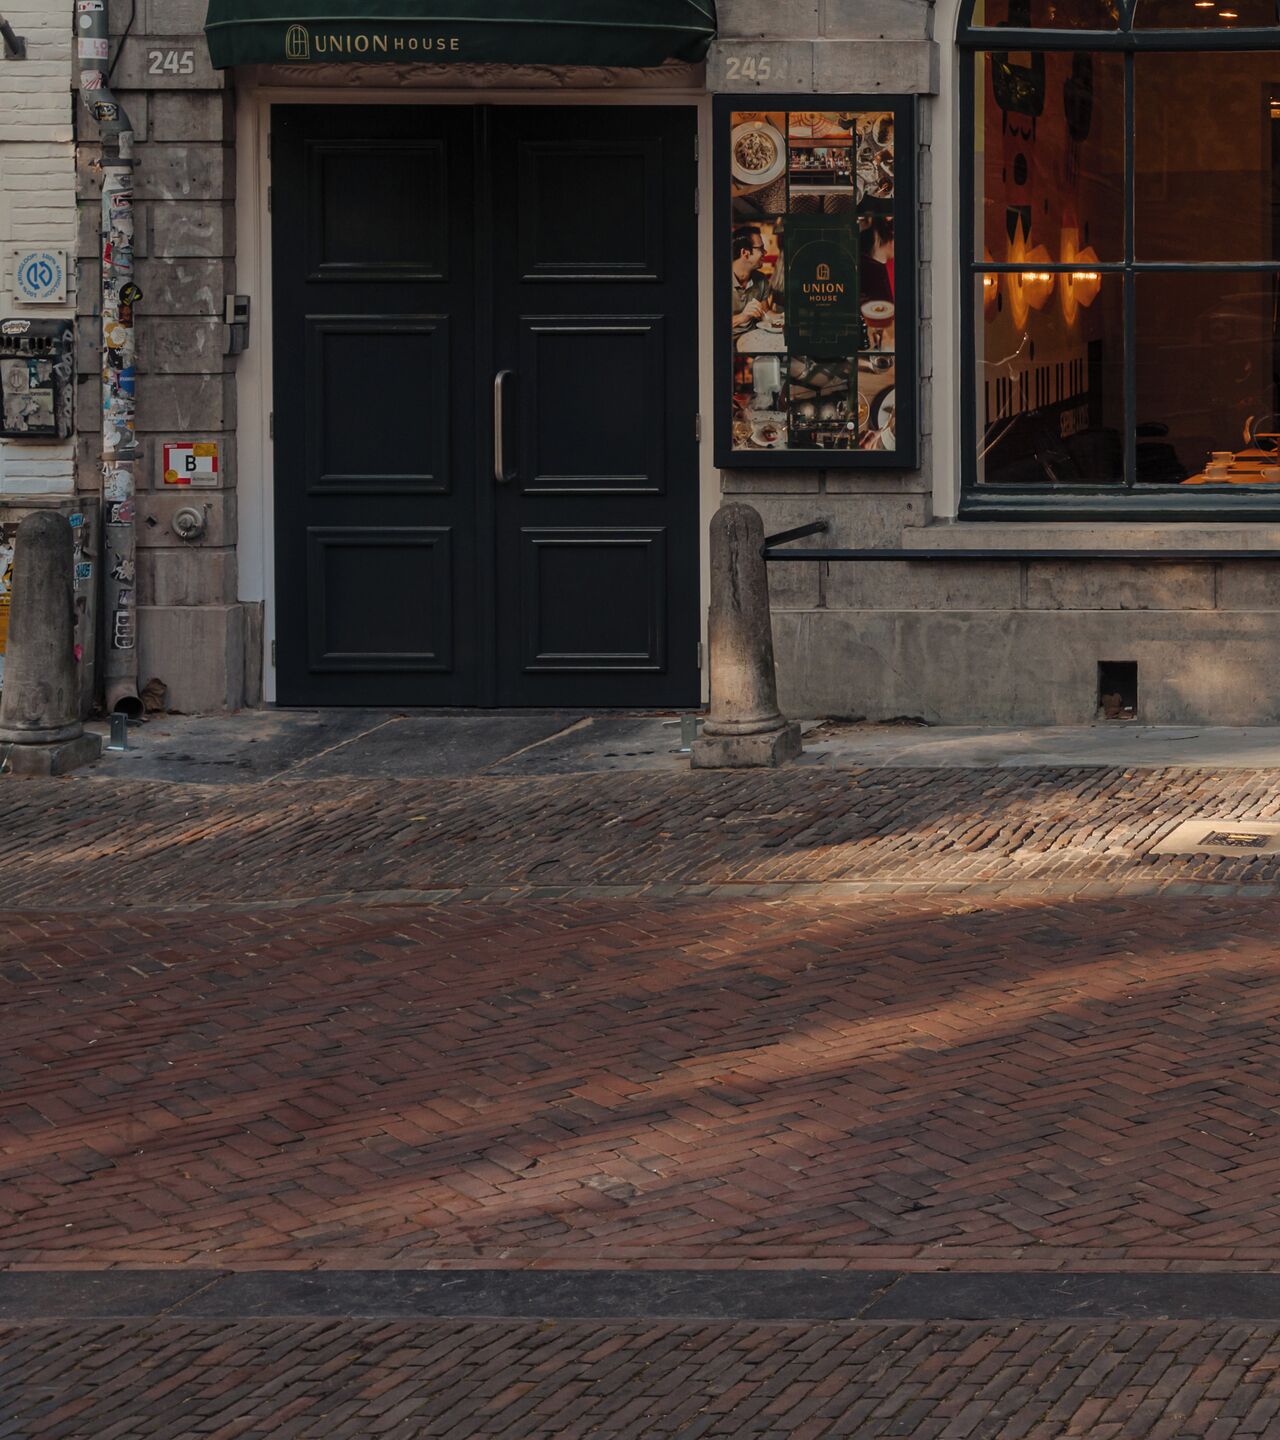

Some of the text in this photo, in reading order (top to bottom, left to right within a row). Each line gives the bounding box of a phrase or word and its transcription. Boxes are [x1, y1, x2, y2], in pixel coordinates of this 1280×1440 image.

[314, 35, 460, 53] UNION HOUSE
[148, 50, 194, 74] 245
[726, 56, 771, 80] 245
[803, 283, 844, 293] UNION
[185, 455, 197, 472] B
